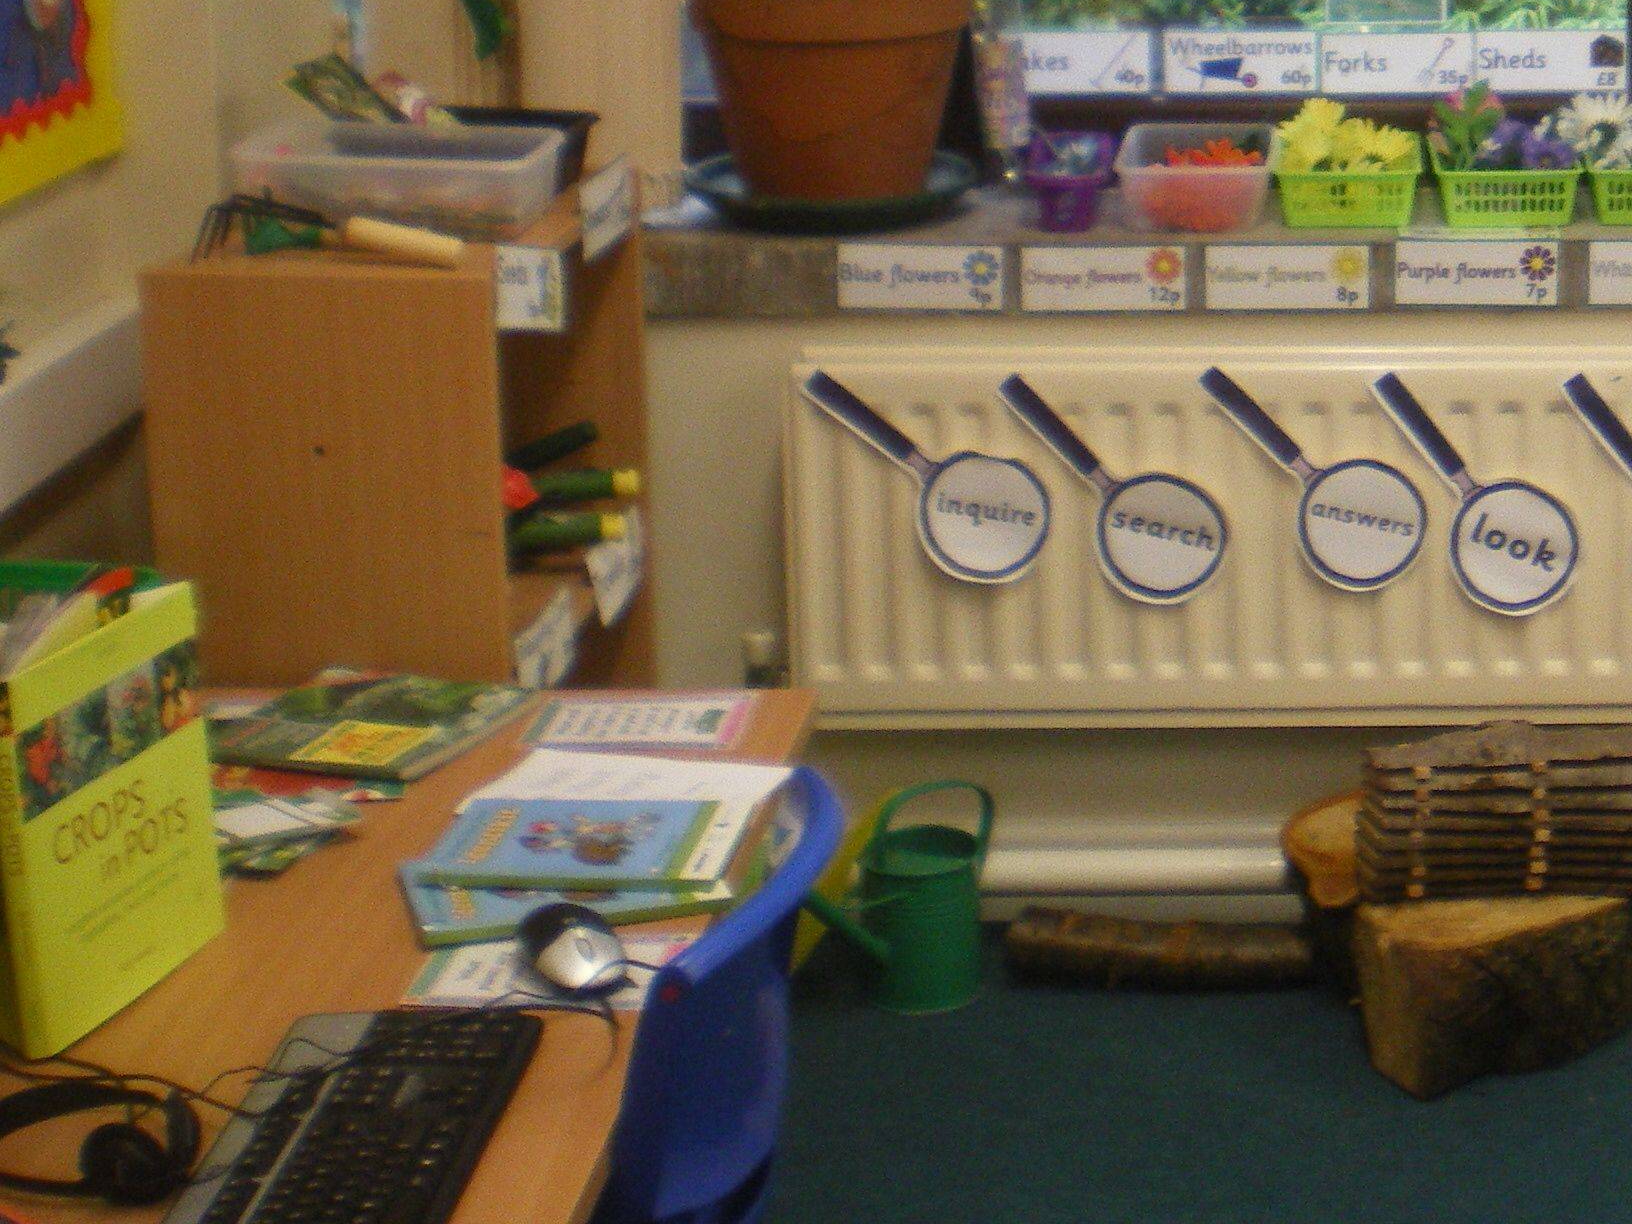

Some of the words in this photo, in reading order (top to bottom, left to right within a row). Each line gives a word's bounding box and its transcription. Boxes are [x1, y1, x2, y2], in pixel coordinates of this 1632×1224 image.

[1019, 49, 1069, 72] akes
[1171, 37, 1314, 58] Wheelbarrows
[1478, 47, 1547, 70] Sheds
[1323, 50, 1387, 73] Forks
[839, 262, 882, 284] Blue
[890, 263, 961, 288] flowers
[1398, 260, 1448, 285] Purple
[1455, 260, 1517, 286] flowers
[1149, 285, 1181, 304] 12p
[1526, 284, 1547, 303] 7p
[935, 491, 1037, 528] inquire
[1311, 500, 1415, 539] answers
[1111, 508, 1216, 552] search
[1470, 512, 1559, 573] look
[53, 778, 146, 866] CROPS
